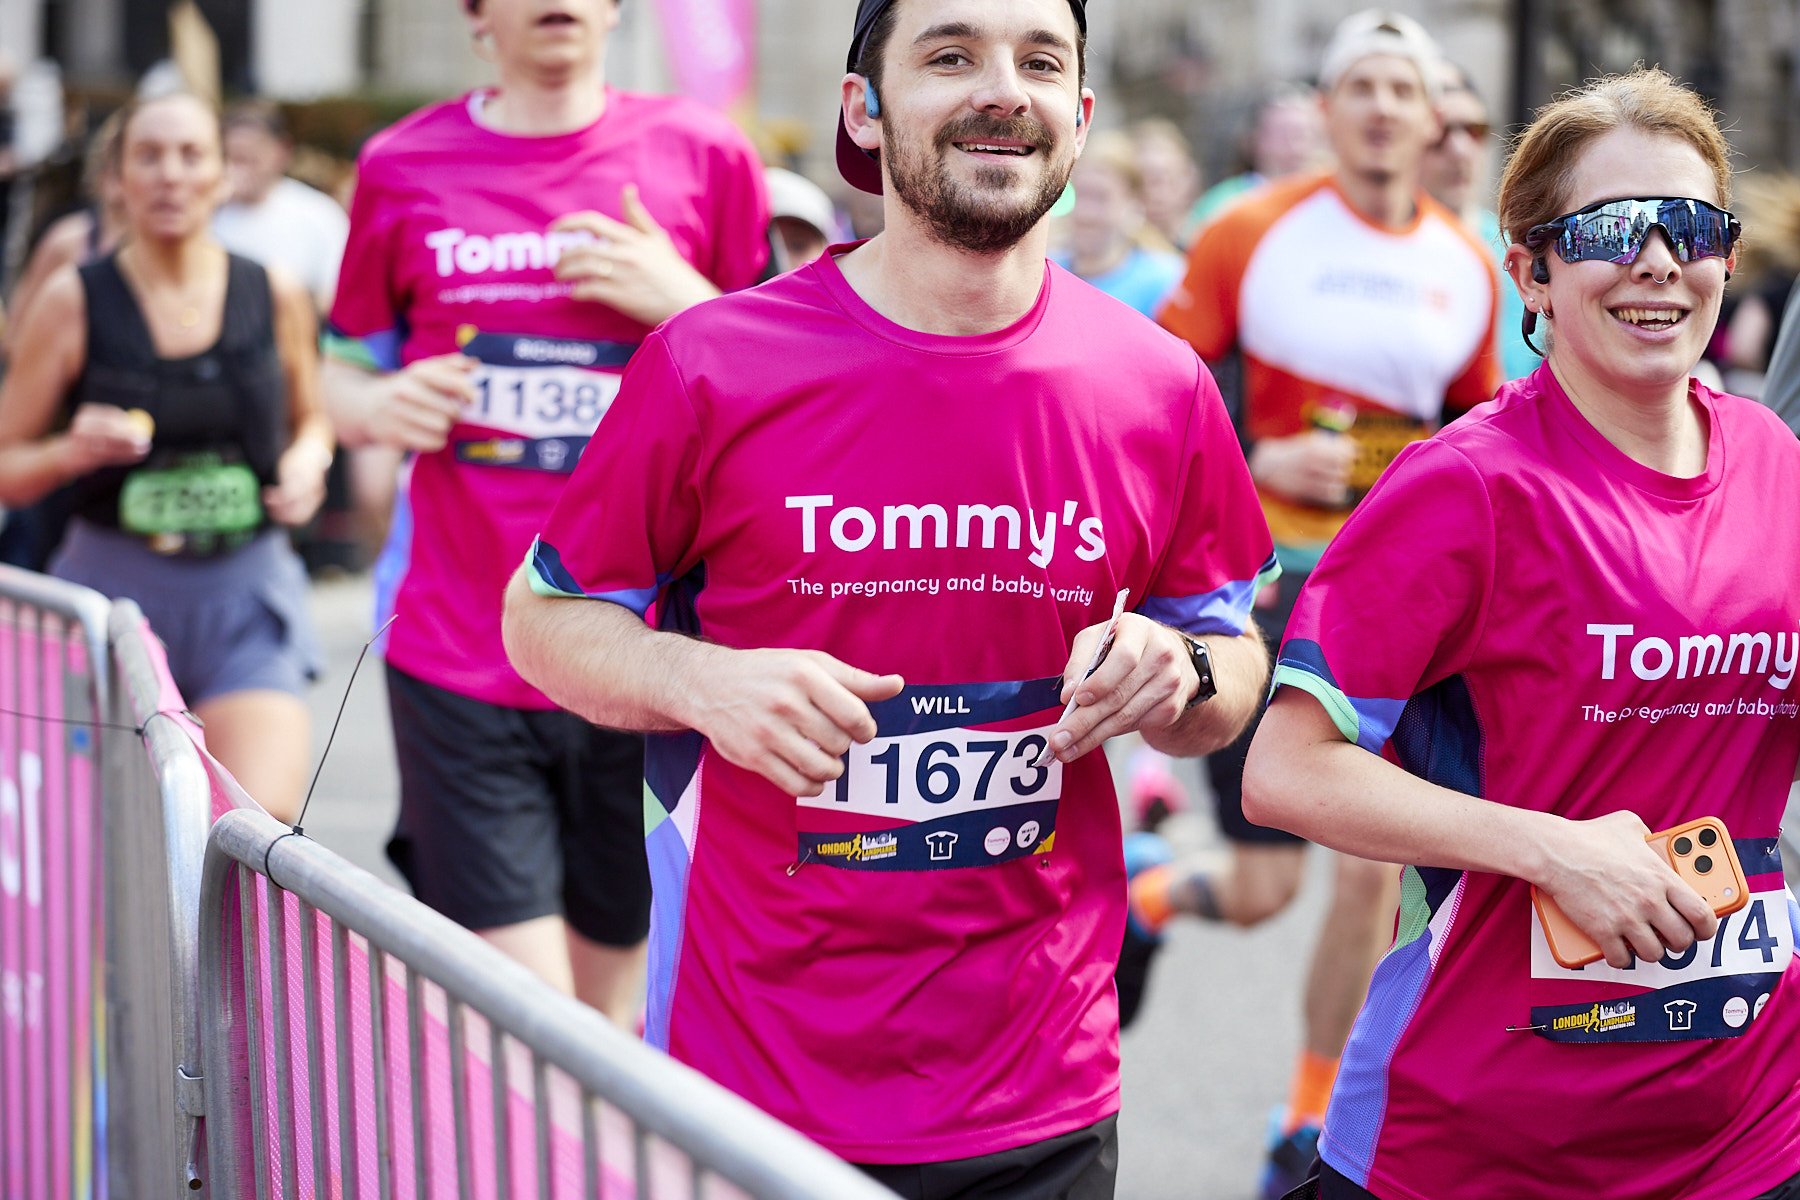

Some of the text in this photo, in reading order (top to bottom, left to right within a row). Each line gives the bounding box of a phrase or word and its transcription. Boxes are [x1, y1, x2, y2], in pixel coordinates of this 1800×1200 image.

[475, 377, 602, 425] 1138
[785, 494, 1106, 569] Tommy's
[787, 579, 824, 595] The
[830, 577, 940, 598] pregnancy
[946, 574, 985, 592] and
[992, 574, 1044, 597] baby
[1586, 621, 1800, 690] Tommy
[911, 696, 971, 715] WILL
[1581, 704, 1617, 722] The
[1704, 698, 1736, 716] and
[1023, 833, 1031, 843] 4
[817, 841, 852, 856] LONDON
[939, 842, 944, 853] L
[1553, 1012, 1590, 1030] LONDON
[1600, 1014, 1636, 1028] LANDMARKS
[1677, 1011, 1683, 1023] S
